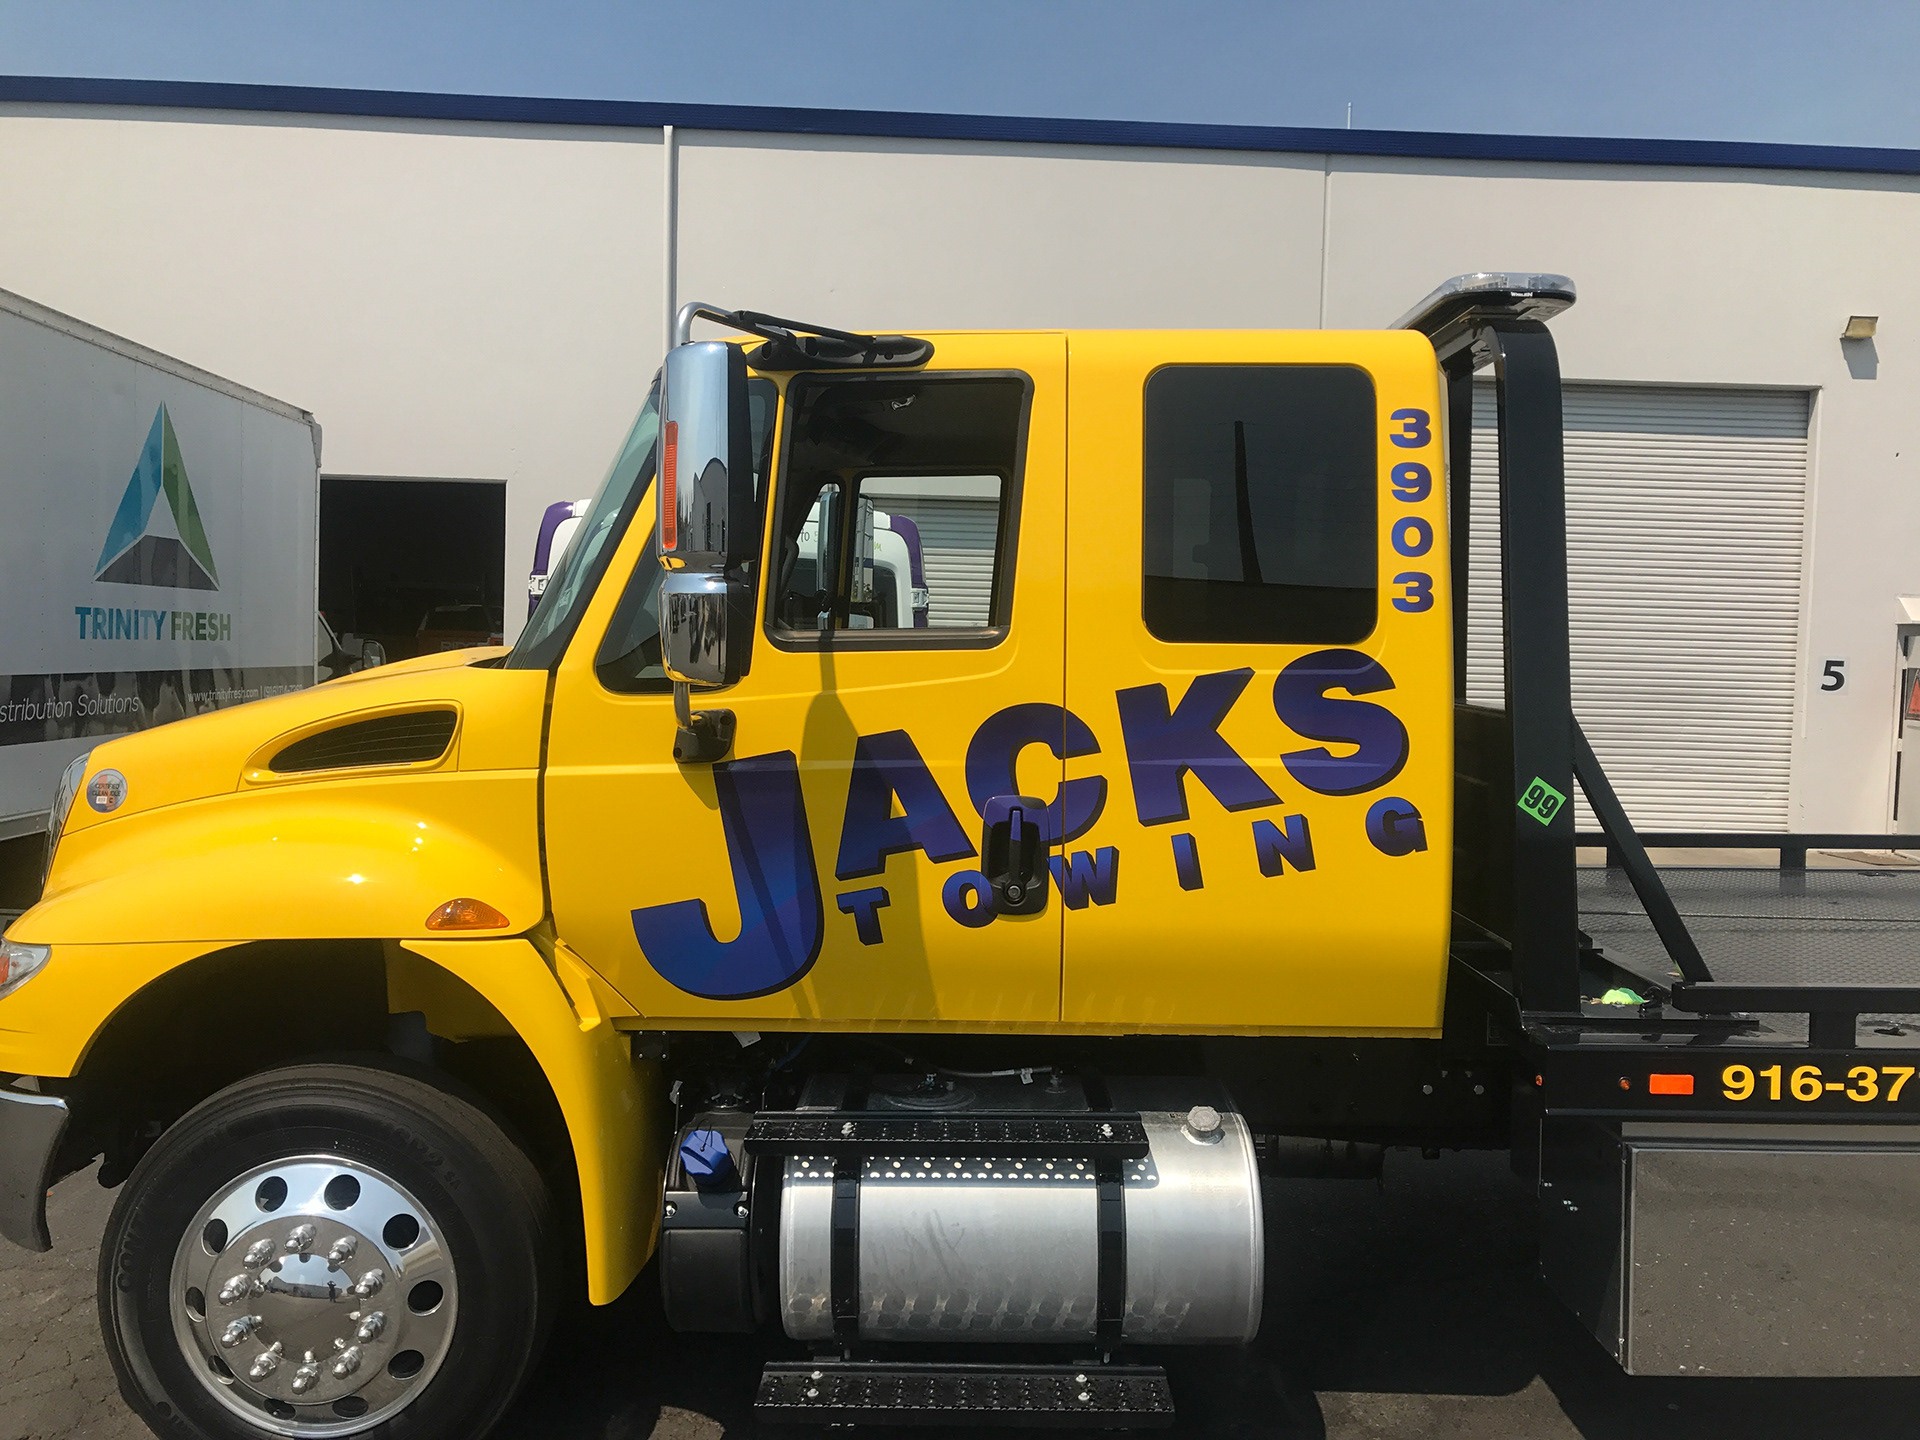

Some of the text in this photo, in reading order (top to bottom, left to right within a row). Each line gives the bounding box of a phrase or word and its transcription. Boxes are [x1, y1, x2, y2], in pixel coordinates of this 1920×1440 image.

[1389, 407, 1435, 613] 3903
[74, 606, 232, 642] TRINITY FRESH
[1820, 660, 1845, 691] 5
[76, 692, 140, 718] Solutions
[1524, 784, 1560, 818] 99
[631, 648, 1411, 1001] JACKS
[836, 796, 1429, 946] TOWING
[1721, 1064, 1920, 1102] 916-37
